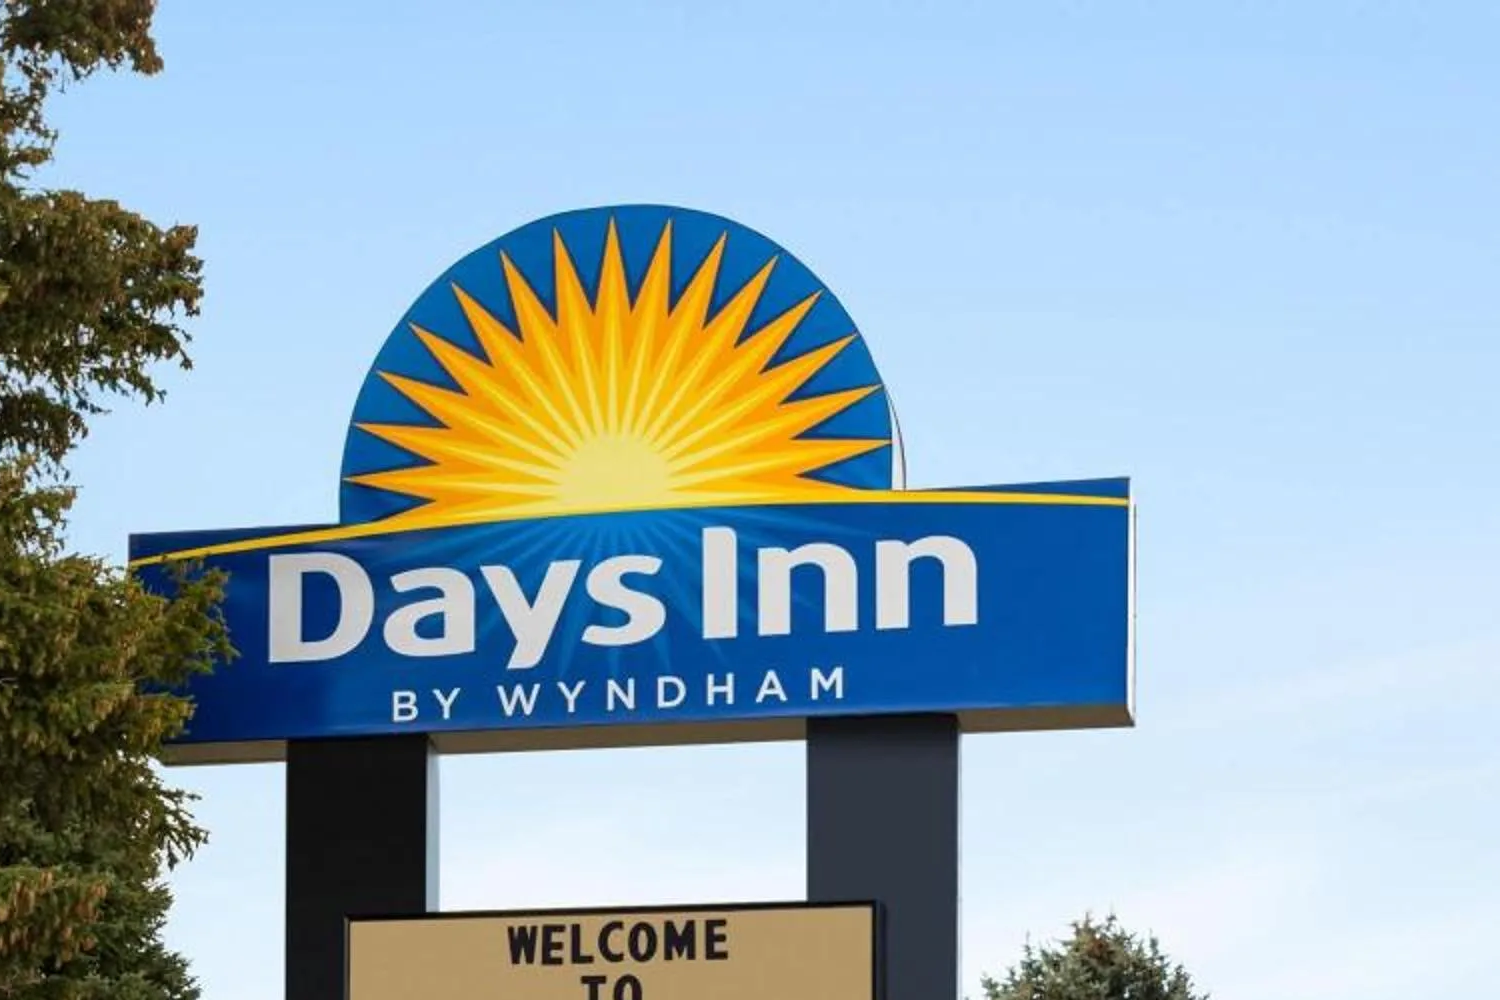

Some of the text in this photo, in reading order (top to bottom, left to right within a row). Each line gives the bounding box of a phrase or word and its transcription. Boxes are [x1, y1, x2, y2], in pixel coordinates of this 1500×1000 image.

[268, 526, 978, 669] Days Inn
[391, 667, 844, 723] BY WYNDHAM
[507, 918, 730, 966] WELCOME
